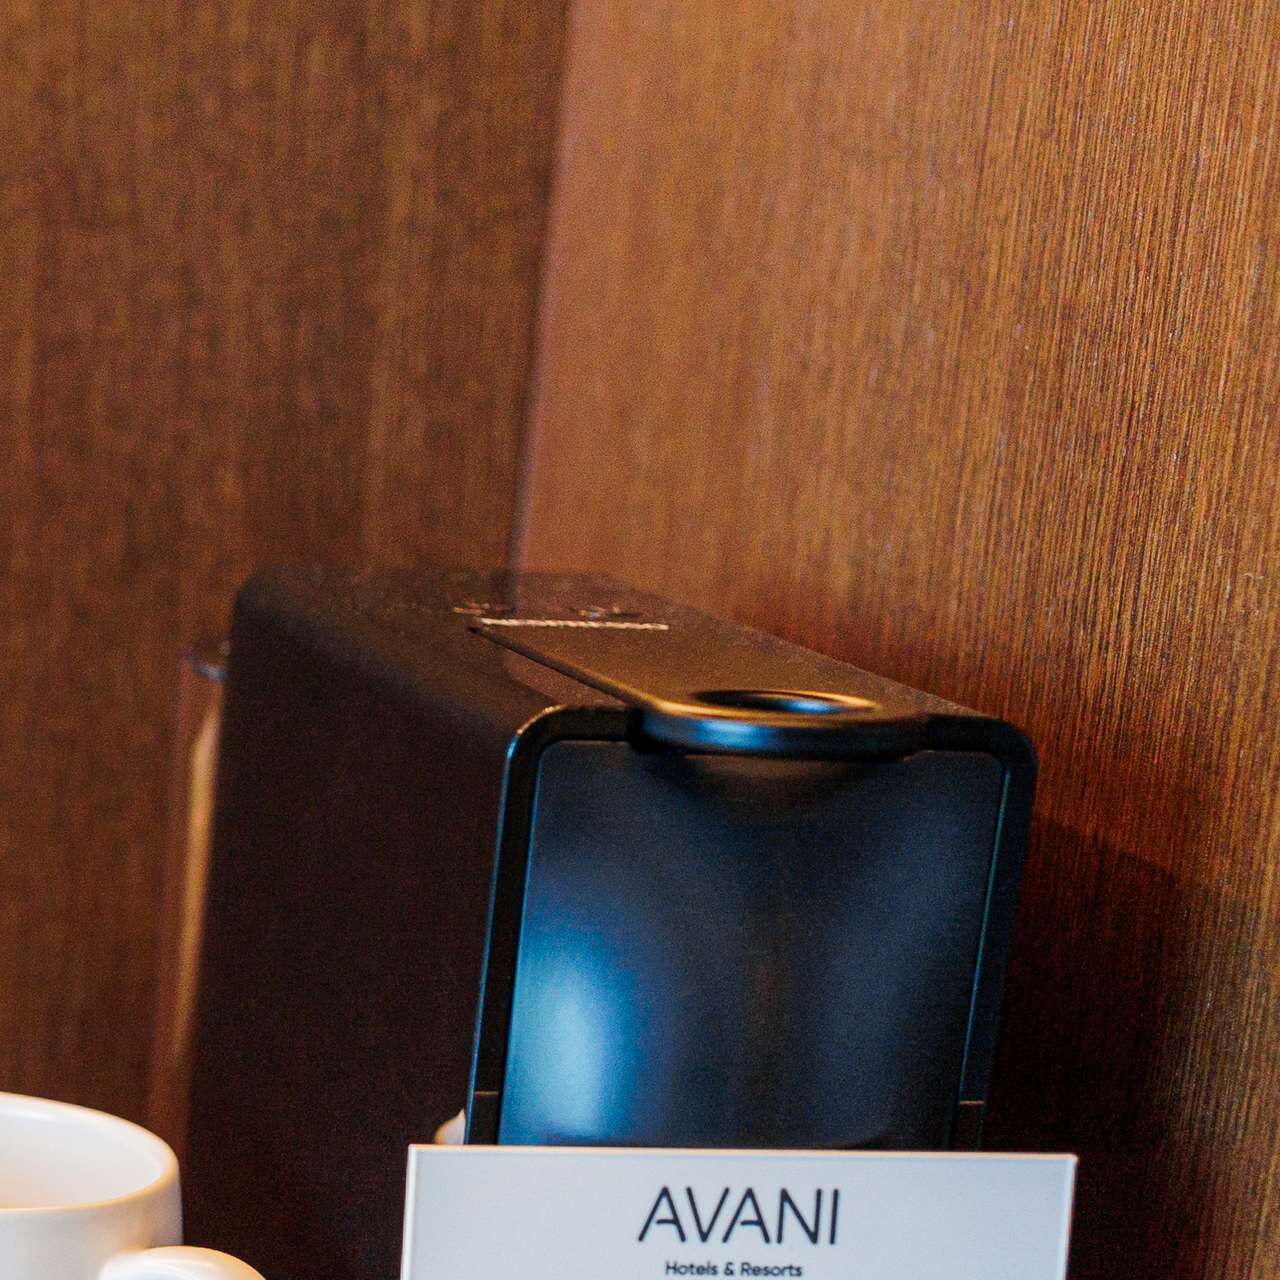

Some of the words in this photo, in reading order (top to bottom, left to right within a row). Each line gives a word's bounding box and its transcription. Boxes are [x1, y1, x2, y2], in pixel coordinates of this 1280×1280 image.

[638, 1186, 840, 1245] AVANI
[664, 1260, 719, 1278] Hotels
[723, 1261, 735, 1278] &
[739, 1261, 803, 1278] Resorts
